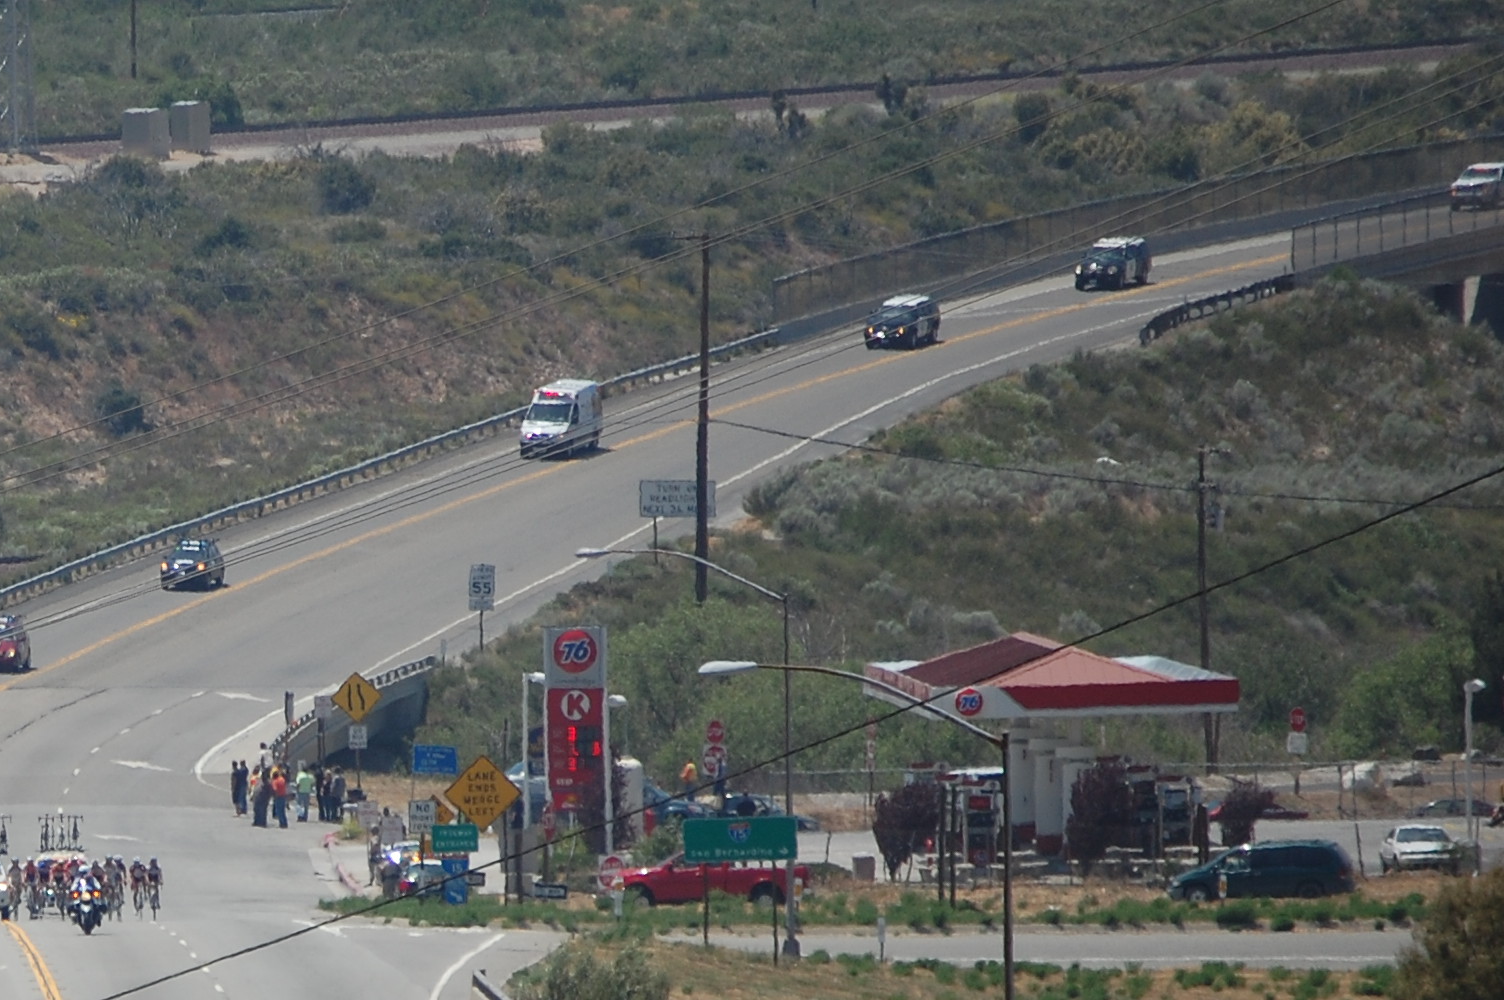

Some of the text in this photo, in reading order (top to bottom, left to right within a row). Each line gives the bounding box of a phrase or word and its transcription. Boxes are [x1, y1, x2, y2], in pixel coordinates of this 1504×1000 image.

[472, 582, 491, 594] 55
[559, 640, 590, 663] 76
[567, 693, 587, 716] K
[960, 695, 979, 710] 76
[467, 771, 496, 781] LANE
[468, 784, 497, 793] ENDS
[463, 794, 500, 804] MERGE
[416, 803, 430, 812] NO
[468, 807, 496, 817] LEFT
[733, 829, 746, 841] 15
